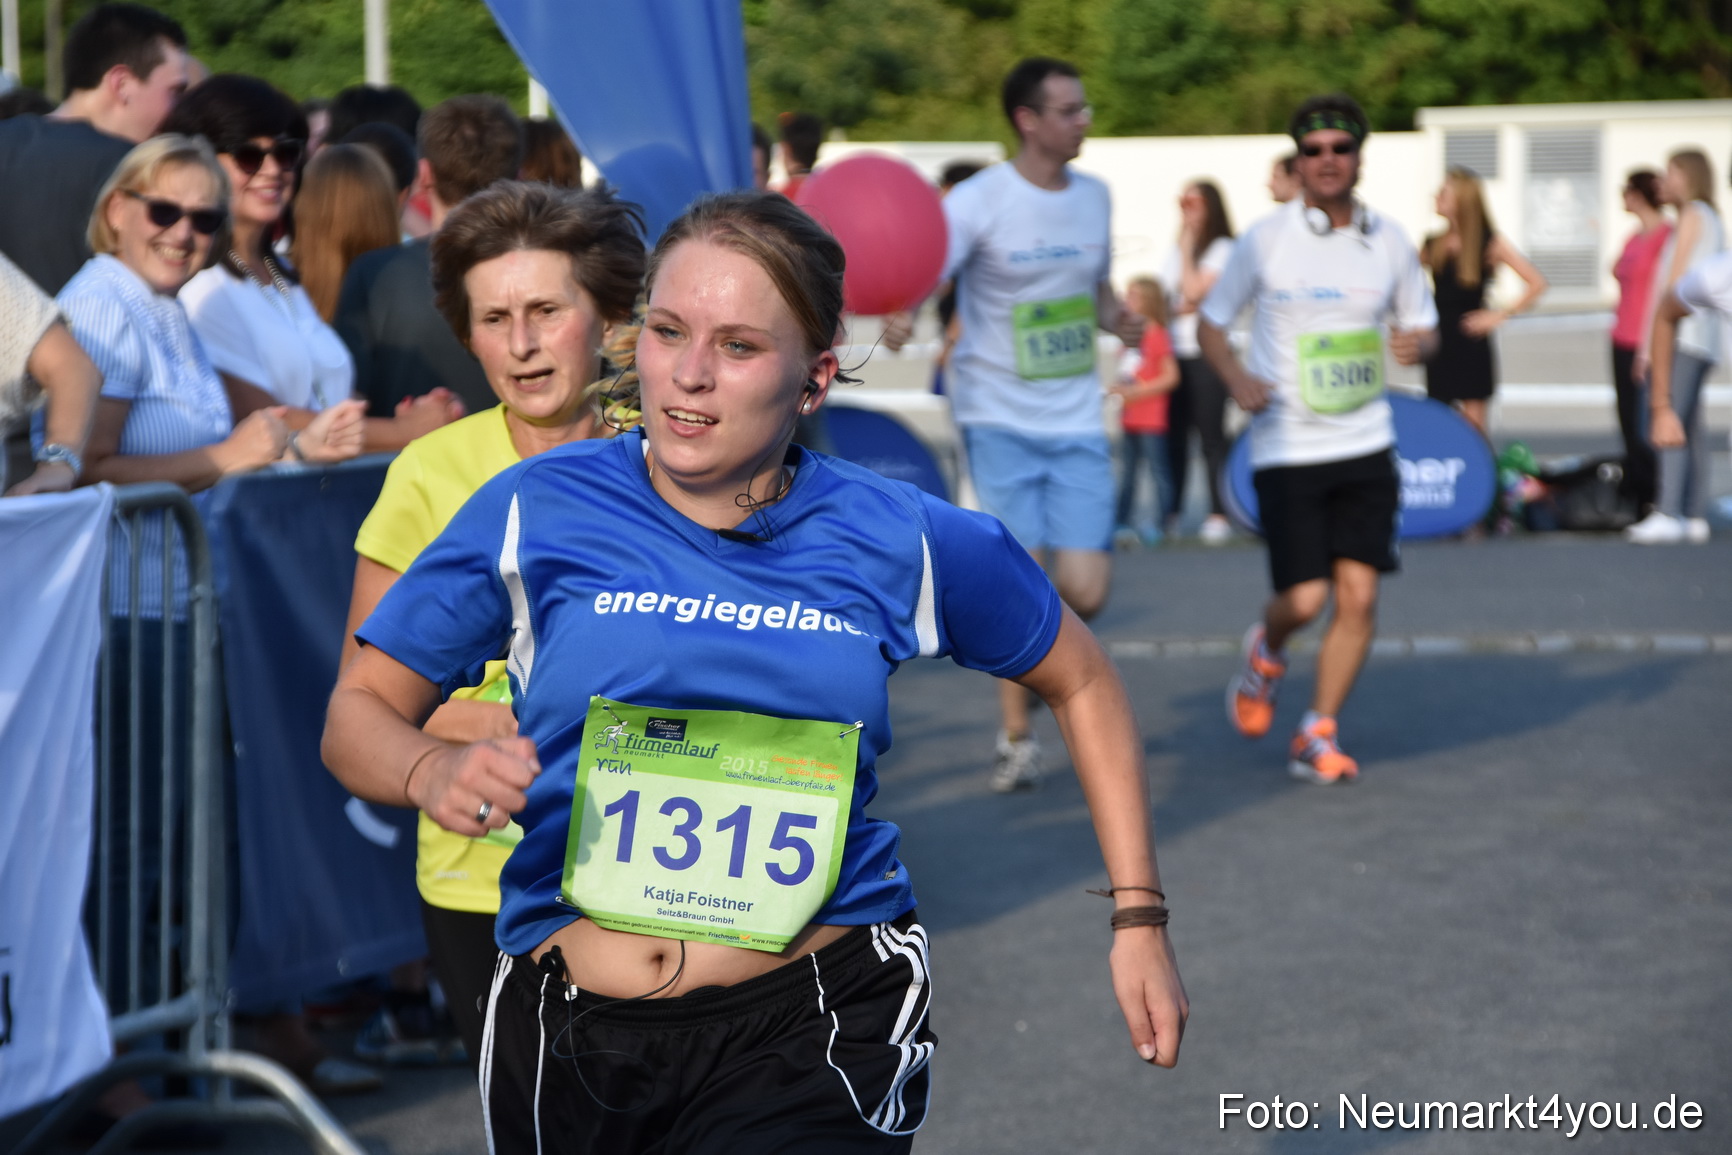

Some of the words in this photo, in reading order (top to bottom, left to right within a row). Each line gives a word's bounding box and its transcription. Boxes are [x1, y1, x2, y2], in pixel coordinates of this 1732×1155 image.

[1310, 359, 1378, 389] 1306
[623, 748, 665, 759] neumarkt
[625, 732, 720, 759] firmenlauf
[719, 755, 769, 775] 2015
[771, 754, 808, 766] Gesunde
[810, 759, 838, 771] Firmen
[725, 771, 836, 792] www.firmenlauf-oberpfalz.de
[785, 766, 811, 777] laufen
[813, 769, 844, 782] länger!
[603, 789, 818, 887] 1315
[643, 885, 684, 905] Katja
[687, 891, 754, 912] Foistner
[656, 907, 707, 921] Seitz&Braun
[708, 915, 735, 925] GmbH
[631, 921, 652, 930] gedruckt
[662, 926, 696, 936] personalisiert
[708, 931, 740, 941] Frischmann
